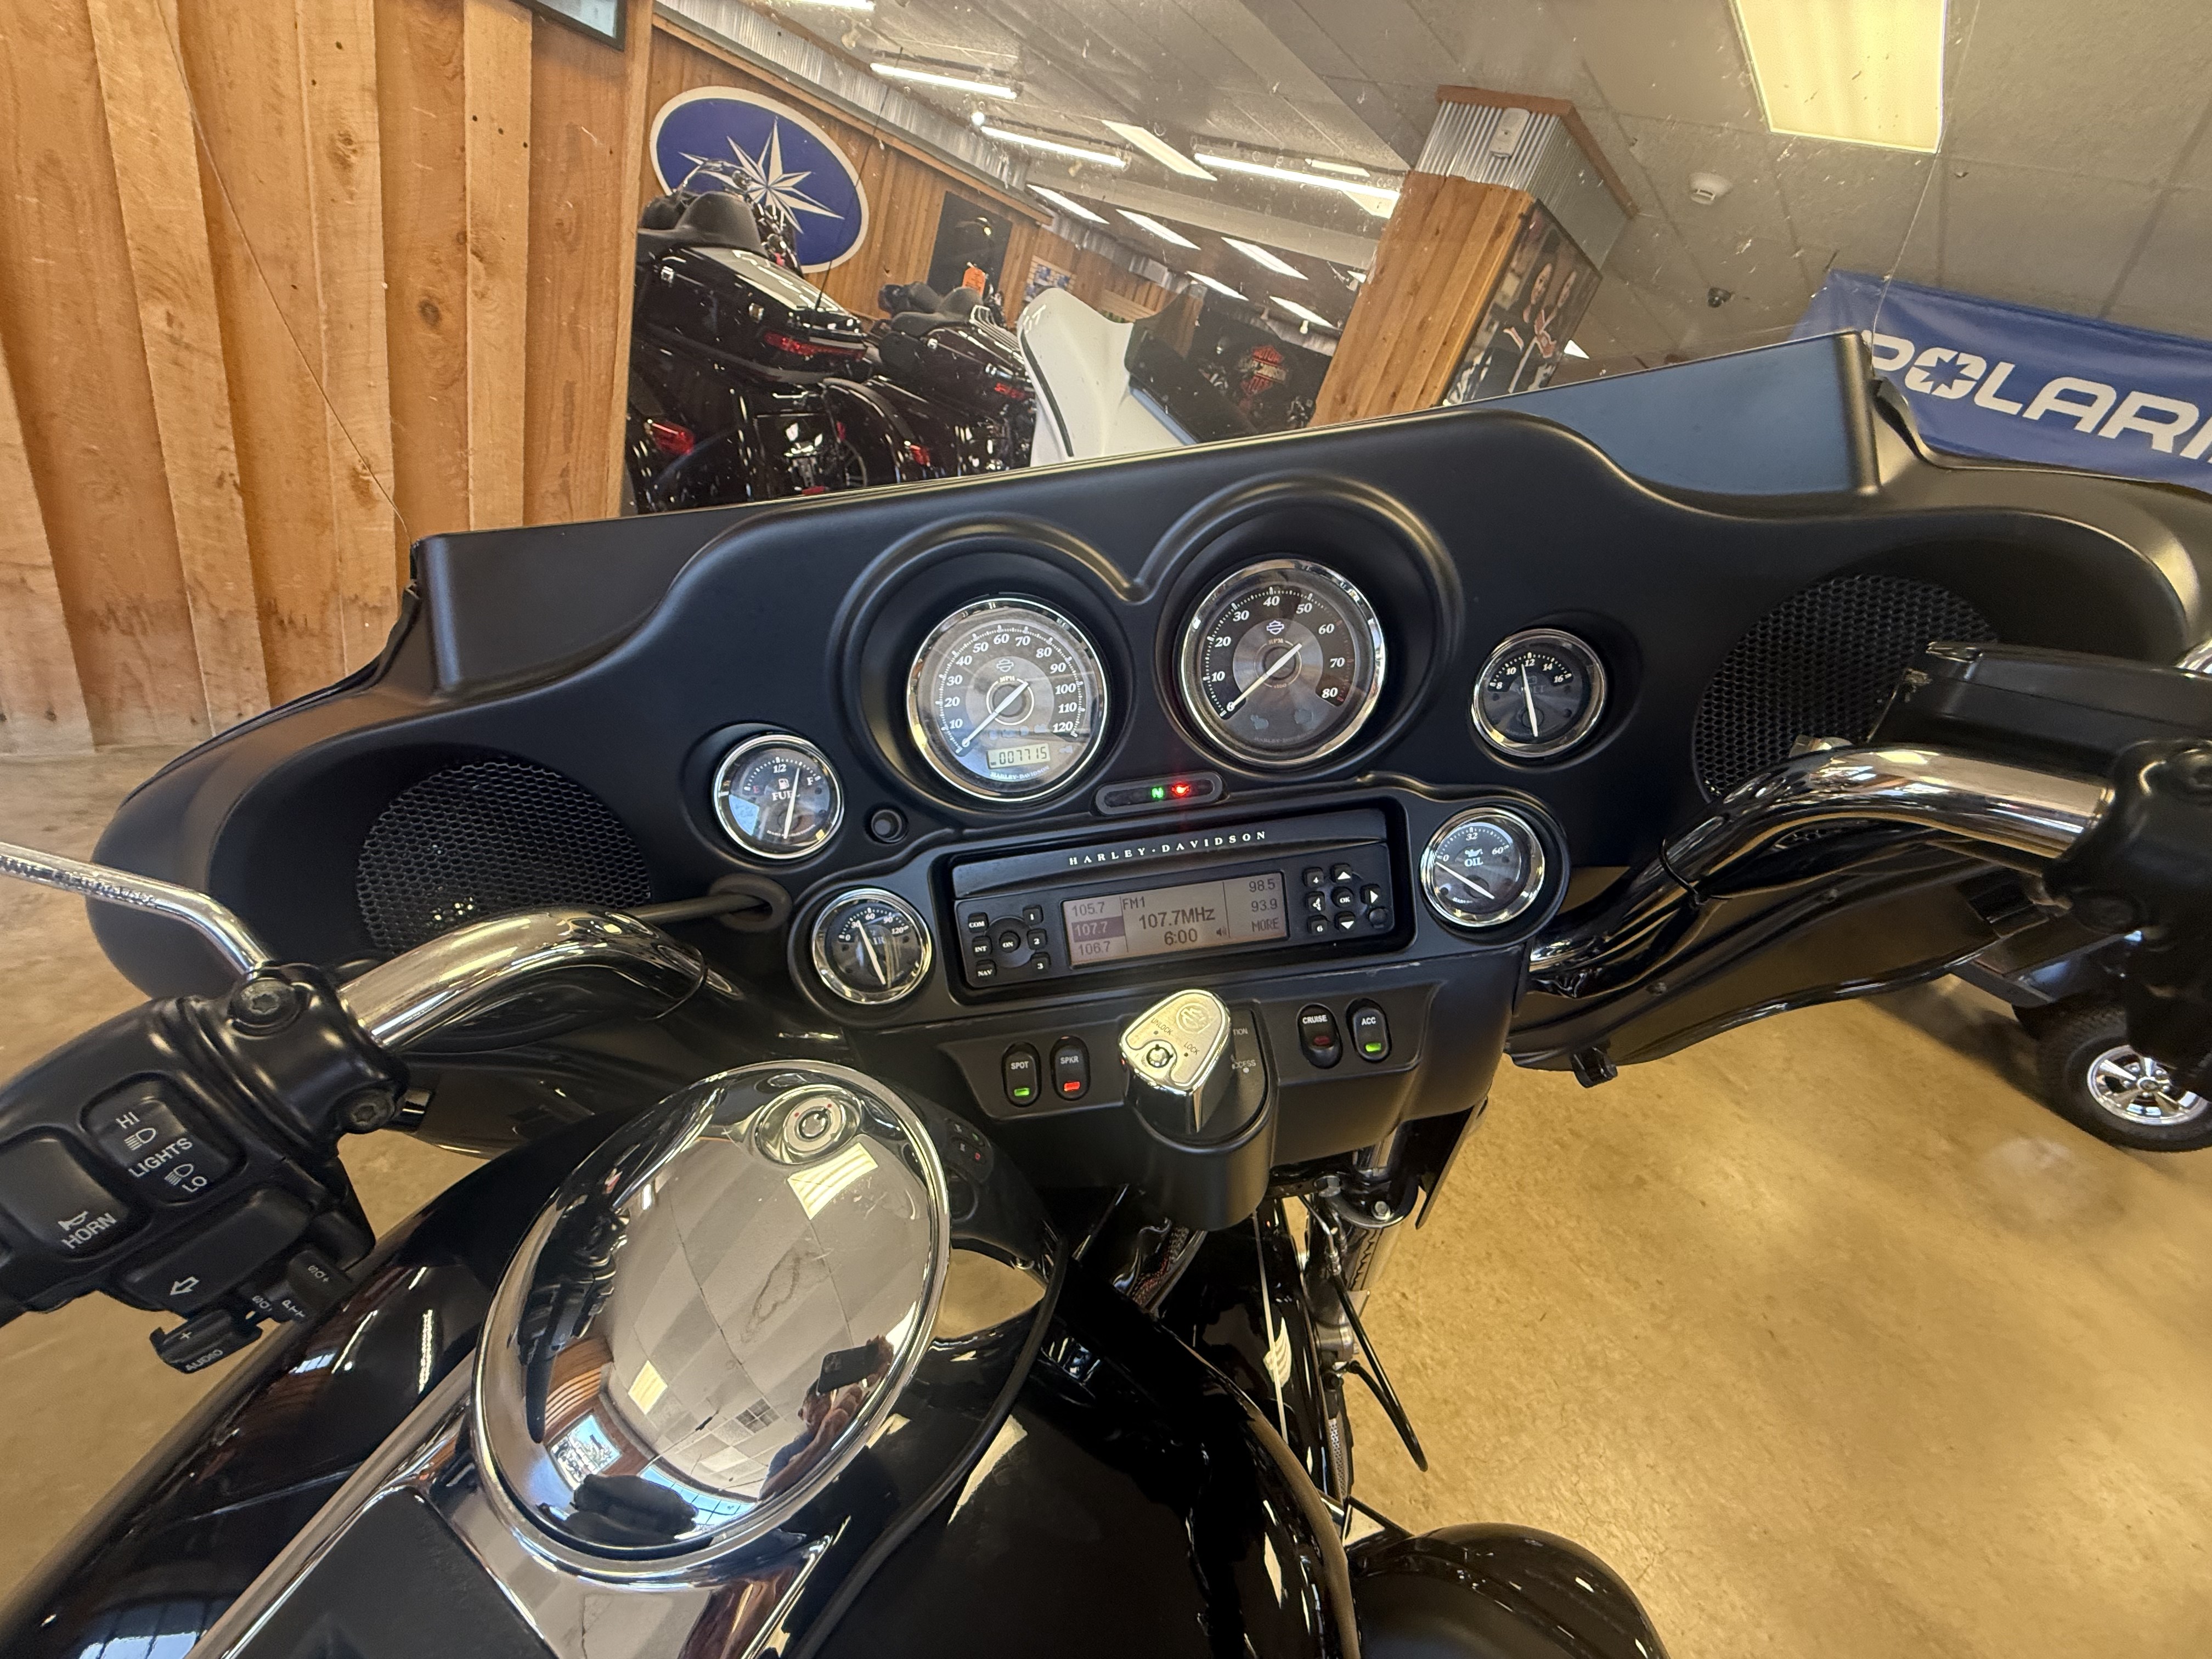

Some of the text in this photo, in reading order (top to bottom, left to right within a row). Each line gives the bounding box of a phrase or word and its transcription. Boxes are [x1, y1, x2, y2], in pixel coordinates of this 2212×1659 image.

[1860, 329, 2212, 464] POLARI
[1263, 596, 1280, 607] 40
[1296, 603, 1312, 614] 50
[1232, 610, 1249, 622] 30
[1318, 623, 1335, 635] 60
[994, 633, 1009, 644] 60
[1015, 635, 1030, 646] 70
[1215, 636, 1232, 647] 20
[973, 641, 989, 653] 50
[1036, 647, 1052, 658] 80
[956, 656, 972, 665] 40
[1330, 658, 1345, 668] 70
[1525, 658, 1536, 667] 12
[1050, 662, 1066, 674] 90
[1506, 667, 1517, 675] 10
[1543, 663, 1553, 672] 14
[946, 674, 963, 686] 30
[1211, 671, 1225, 682] 10
[1554, 675, 1564, 684] 16
[1055, 683, 1076, 695] 100
[1496, 681, 1503, 690] 8
[1322, 688, 1338, 698] 80
[945, 697, 960, 708] 20
[1058, 702, 1077, 713] 110
[949, 718, 963, 729] 10
[1053, 721, 1074, 733] 120
[999, 746, 1047, 765] 007715
[772, 763, 787, 774] 1/2
[807, 776, 814, 786] F
[771, 791, 800, 801] FUE
[1465, 832, 1478, 841] 32
[1492, 847, 1504, 855] 60
[1442, 854, 1449, 862] 0
[1464, 857, 1483, 867] OIL
[1249, 878, 1276, 893] 98.5
[1122, 896, 1146, 910] FM1
[1251, 898, 1278, 912] 93.9
[1071, 901, 1105, 917] 105.7
[1139, 906, 1216, 929] 107.7MHz
[1075, 921, 1108, 936] 107.7
[1251, 917, 1280, 933] MORE
[891, 927, 905, 935] 120
[1164, 928, 1198, 946] 6:00
[1078, 940, 1111, 956] 106.7
[977, 969, 993, 977] NAV
[1302, 1014, 1328, 1025] CRUISE
[1361, 1016, 1376, 1026] ACC
[1150, 1017, 1174, 1036] UNLOCK
[1183, 1041, 1200, 1056] LOCK
[1011, 1060, 1029, 1070] SPOT
[1060, 1055, 1080, 1065] SPKR
[115, 1111, 140, 1129] HI
[128, 1138, 193, 1178] LIGHTS
[182, 1176, 208, 1193] LO
[61, 1212, 117, 1249] HORN
[185, 1348, 223, 1371] AUDIO
